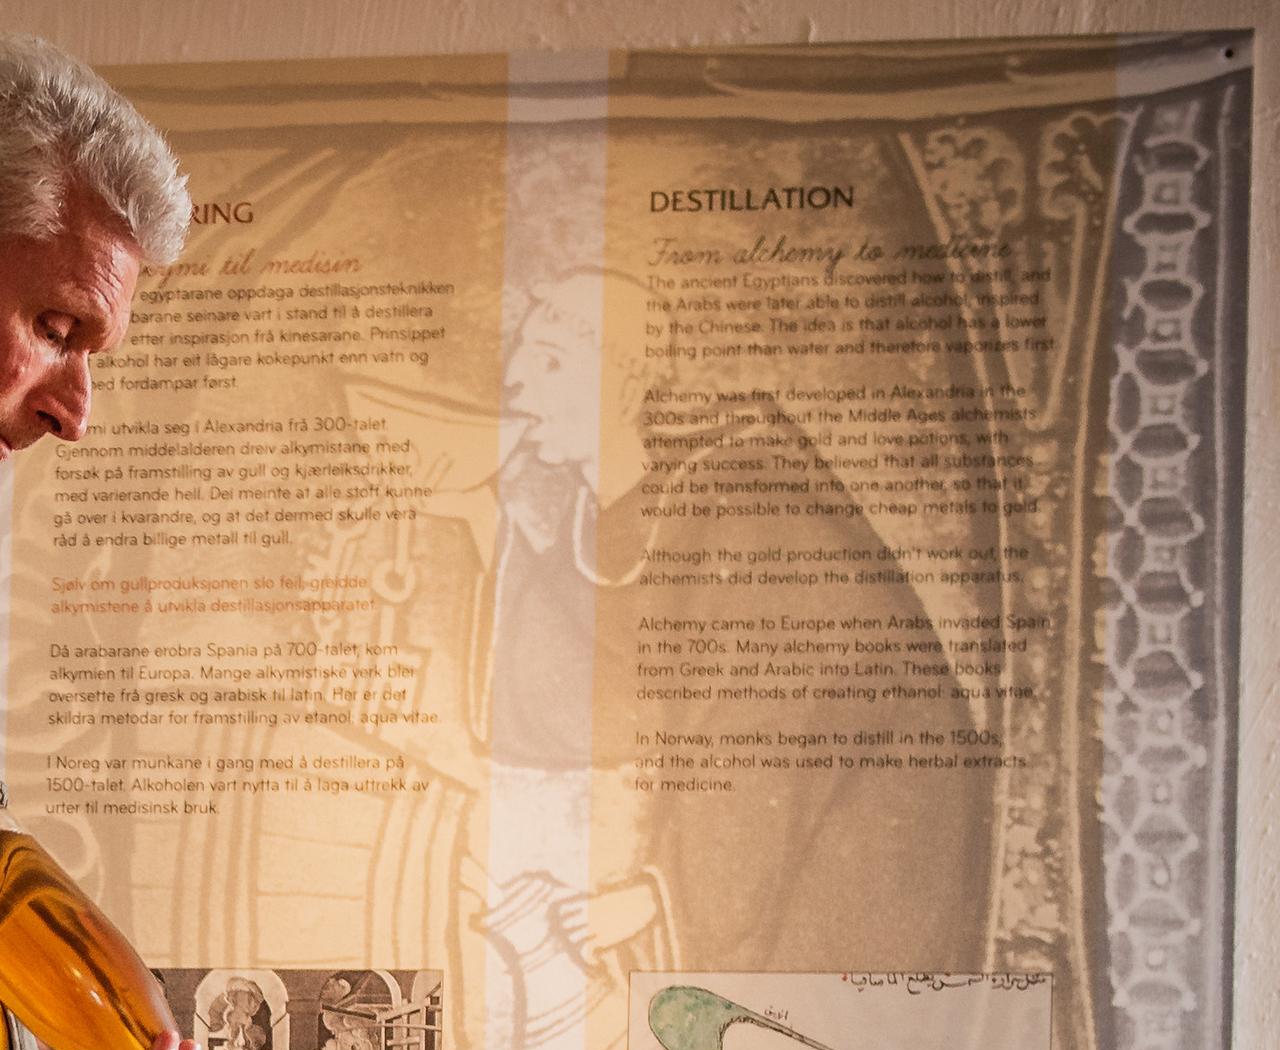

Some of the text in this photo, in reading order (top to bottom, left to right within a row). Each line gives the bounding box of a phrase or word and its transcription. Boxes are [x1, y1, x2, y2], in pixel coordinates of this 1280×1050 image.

[650, 187, 853, 212] DESTILLATION
[220, 248, 255, 275] til
[260, 250, 360, 274] medisin
[732, 235, 848, 278] alchemy
[855, 239, 883, 262] to
[140, 284, 223, 303] egyptarane
[227, 283, 294, 302] oppdaga
[643, 411, 685, 425] 300s
[688, 410, 719, 424] and
[817, 408, 842, 422] the
[848, 407, 901, 422] Middle
[905, 407, 945, 425] Ages
[951, 405, 1037, 420] alchemists
[280, 439, 370, 457] alkymistane
[375, 438, 410, 452] med
[103, 464, 123, 483] på
[127, 463, 211, 483] framstilling
[216, 466, 234, 478] av
[237, 463, 265, 482] gull
[270, 466, 289, 481] og
[53, 531, 77, 545] råd
[94, 531, 137, 545] endra
[142, 531, 186, 549] billige
[191, 530, 238, 544] metall
[243, 530, 256, 544] til
[639, 570, 722, 584] alchemists
[727, 570, 752, 584] did
[757, 570, 818, 587] develop
[823, 570, 849, 583] the
[854, 569, 934, 583] distillation
[638, 615, 706, 633] Alchemy
[710, 618, 755, 629] came
[759, 615, 775, 629] to
[780, 615, 835, 633] Europe
[839, 615, 882, 628] when
[887, 615, 932, 628] Arabs
[938, 614, 1003, 628] invaded
[50, 643, 69, 657] Då
[73, 643, 149, 657] arabarane
[153, 642, 201, 656] erobra
[206, 642, 257, 660] Spania
[263, 642, 281, 660] på
[365, 641, 399, 655] kom
[637, 638, 651, 652] in
[655, 638, 682, 652] the
[736, 638, 779, 656] Many
[783, 638, 849, 655] alchemy
[853, 638, 901, 651] books
[905, 641, 942, 651] were
[49, 665, 115, 683] alkymien
[119, 665, 133, 678] til
[199, 664, 251, 682] Mange
[255, 664, 346, 682] alkymistiske
[637, 661, 676, 675] from
[678, 661, 723, 674] Greek
[729, 661, 759, 674] and
[764, 661, 814, 674] Arabic
[819, 661, 849, 674] into
[903, 660, 951, 674] These
[954, 660, 1002, 674] books
[636, 684, 711, 698] described
[716, 684, 787, 698] methods
[791, 684, 806, 698] of
[812, 684, 876, 702] creating
[635, 730, 649, 744] In
[655, 730, 713, 748] Norway,
[719, 730, 772, 744] monks
[776, 730, 827, 748] began
[830, 730, 847, 744] to
[852, 730, 893, 744] distill
[898, 730, 913, 744] in
[918, 730, 944, 744] the
[47, 755, 51, 768] I
[56, 755, 100, 772] Noreg
[104, 758, 127, 768] var
[131, 755, 202, 768] munkane
[215, 758, 253, 772] gang
[257, 755, 293, 768] med
[312, 755, 380, 768] destillera
[385, 755, 405, 772] på
[635, 753, 664, 767] and
[670, 753, 694, 767] the
[699, 753, 755, 767] alcohol
[795, 754, 833, 767] used
[838, 754, 855, 767] to
[859, 754, 902, 767] make
[908, 754, 957, 767] herbal
[131, 777, 204, 791] Alkoholen
[209, 777, 237, 791] vart
[240, 777, 279, 795] nytta
[284, 777, 298, 791] til
[317, 777, 349, 795] laga
[411, 780, 430, 791] av
[635, 776, 653, 790] for
[45, 800, 80, 813] urter
[84, 800, 98, 813] til
[103, 800, 178, 814] medisinsk
